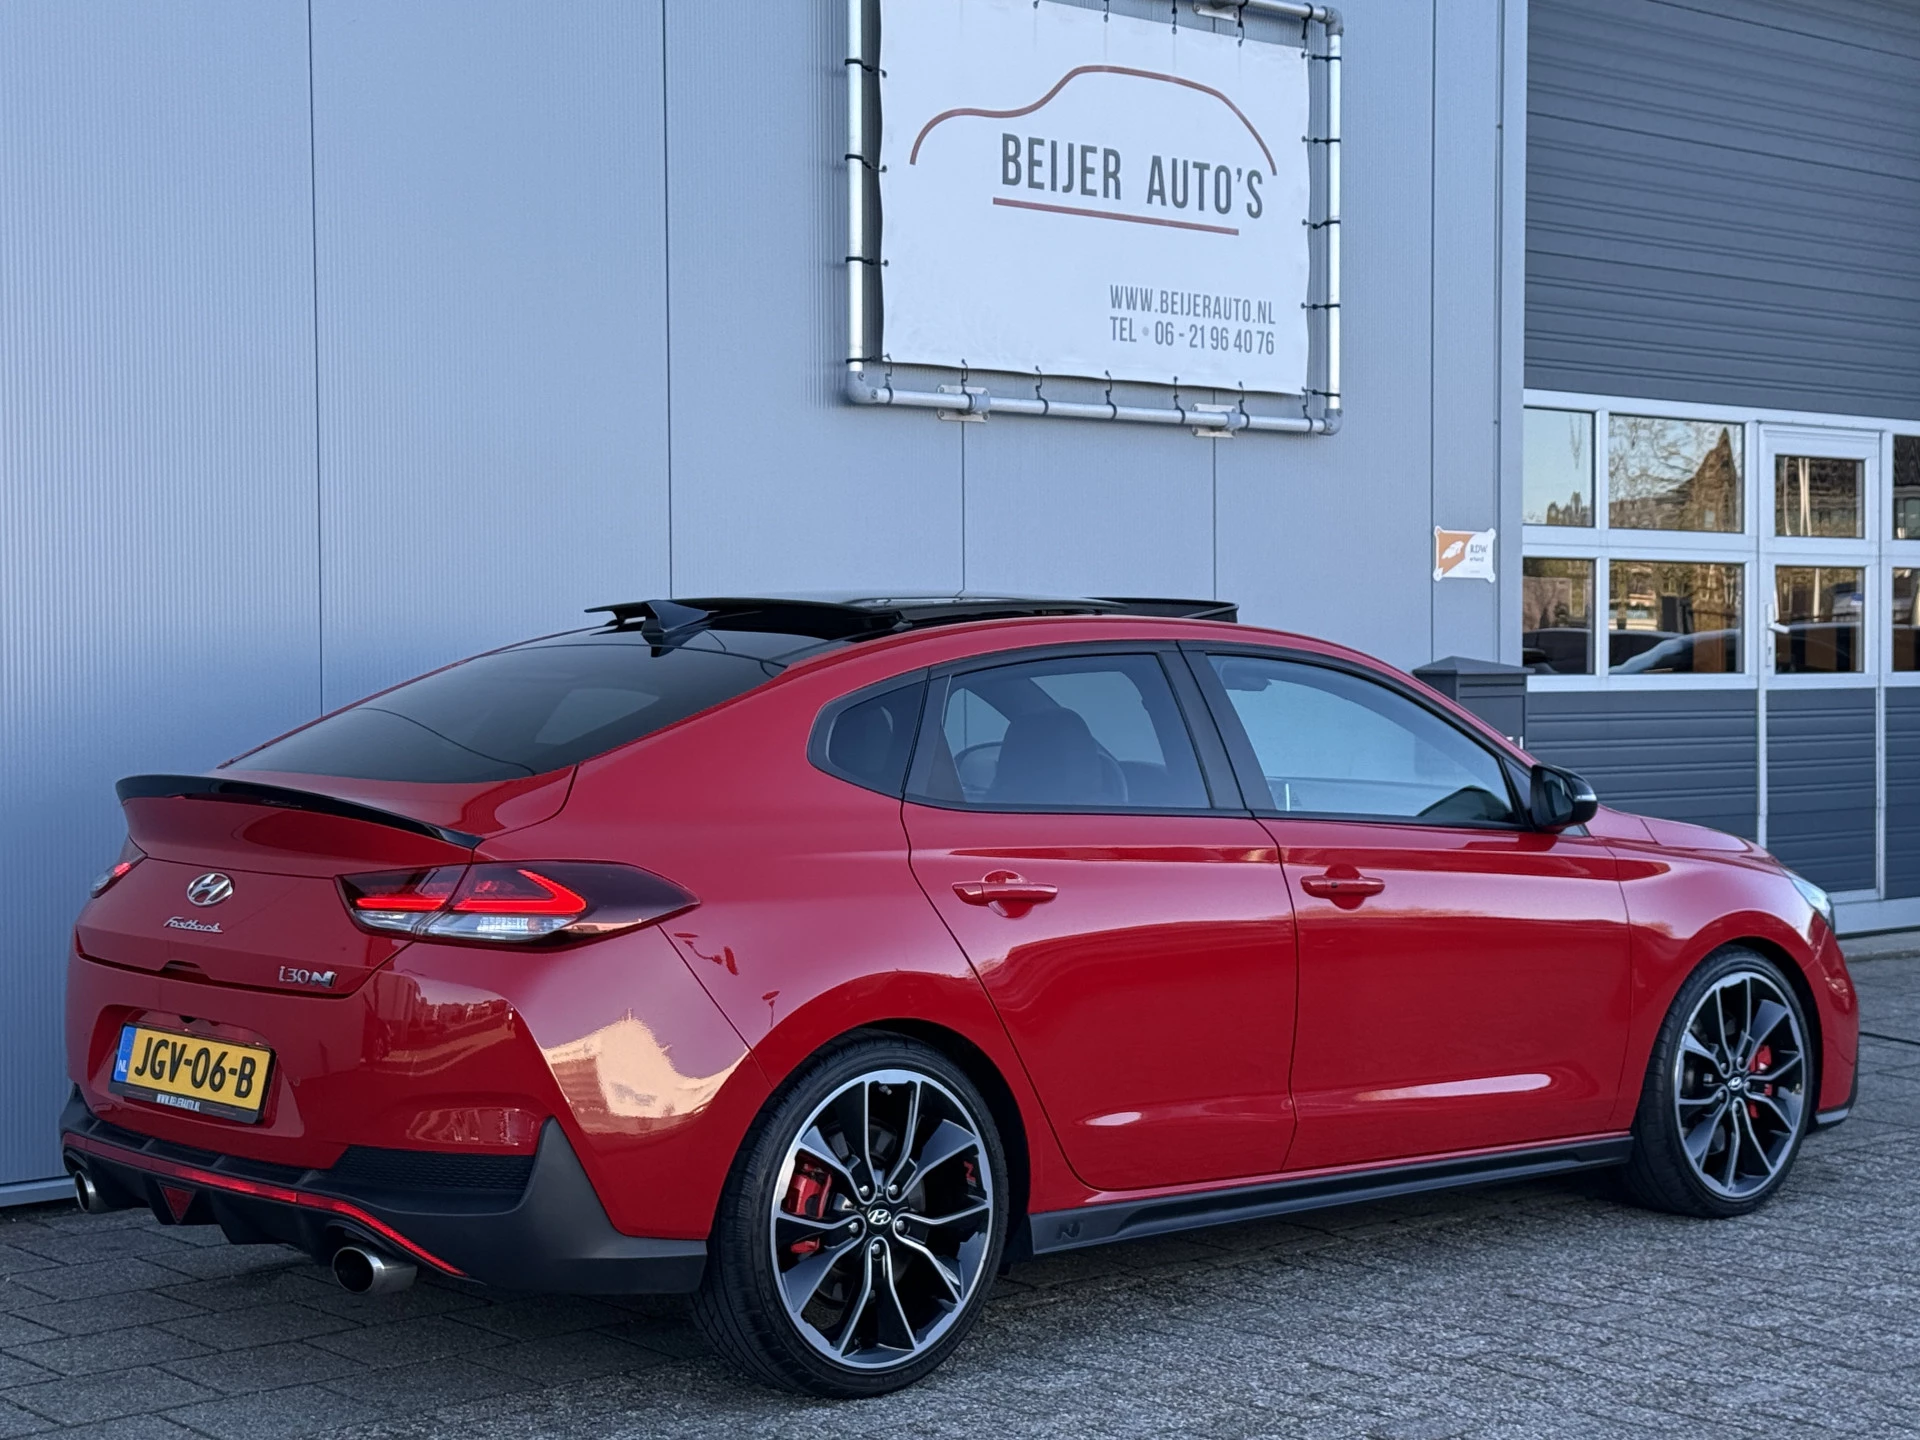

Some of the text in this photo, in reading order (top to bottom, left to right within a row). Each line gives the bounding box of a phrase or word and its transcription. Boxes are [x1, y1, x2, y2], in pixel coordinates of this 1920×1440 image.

[1002, 133, 1263, 219] BEIJER AUTO'S
[1110, 284, 1276, 325] WWW.BEIJERAUTO.NL
[1110, 316, 1137, 343] TEL
[1155, 320, 1174, 346] 06
[1189, 324, 1205, 349] 21
[1210, 326, 1229, 351] 96
[1233, 329, 1252, 353] 40
[1256, 331, 1274, 355] 76
[163, 916, 223, 933] Fastback
[117, 1059, 127, 1073] NL
[134, 1037, 256, 1098] JGV-06-B
